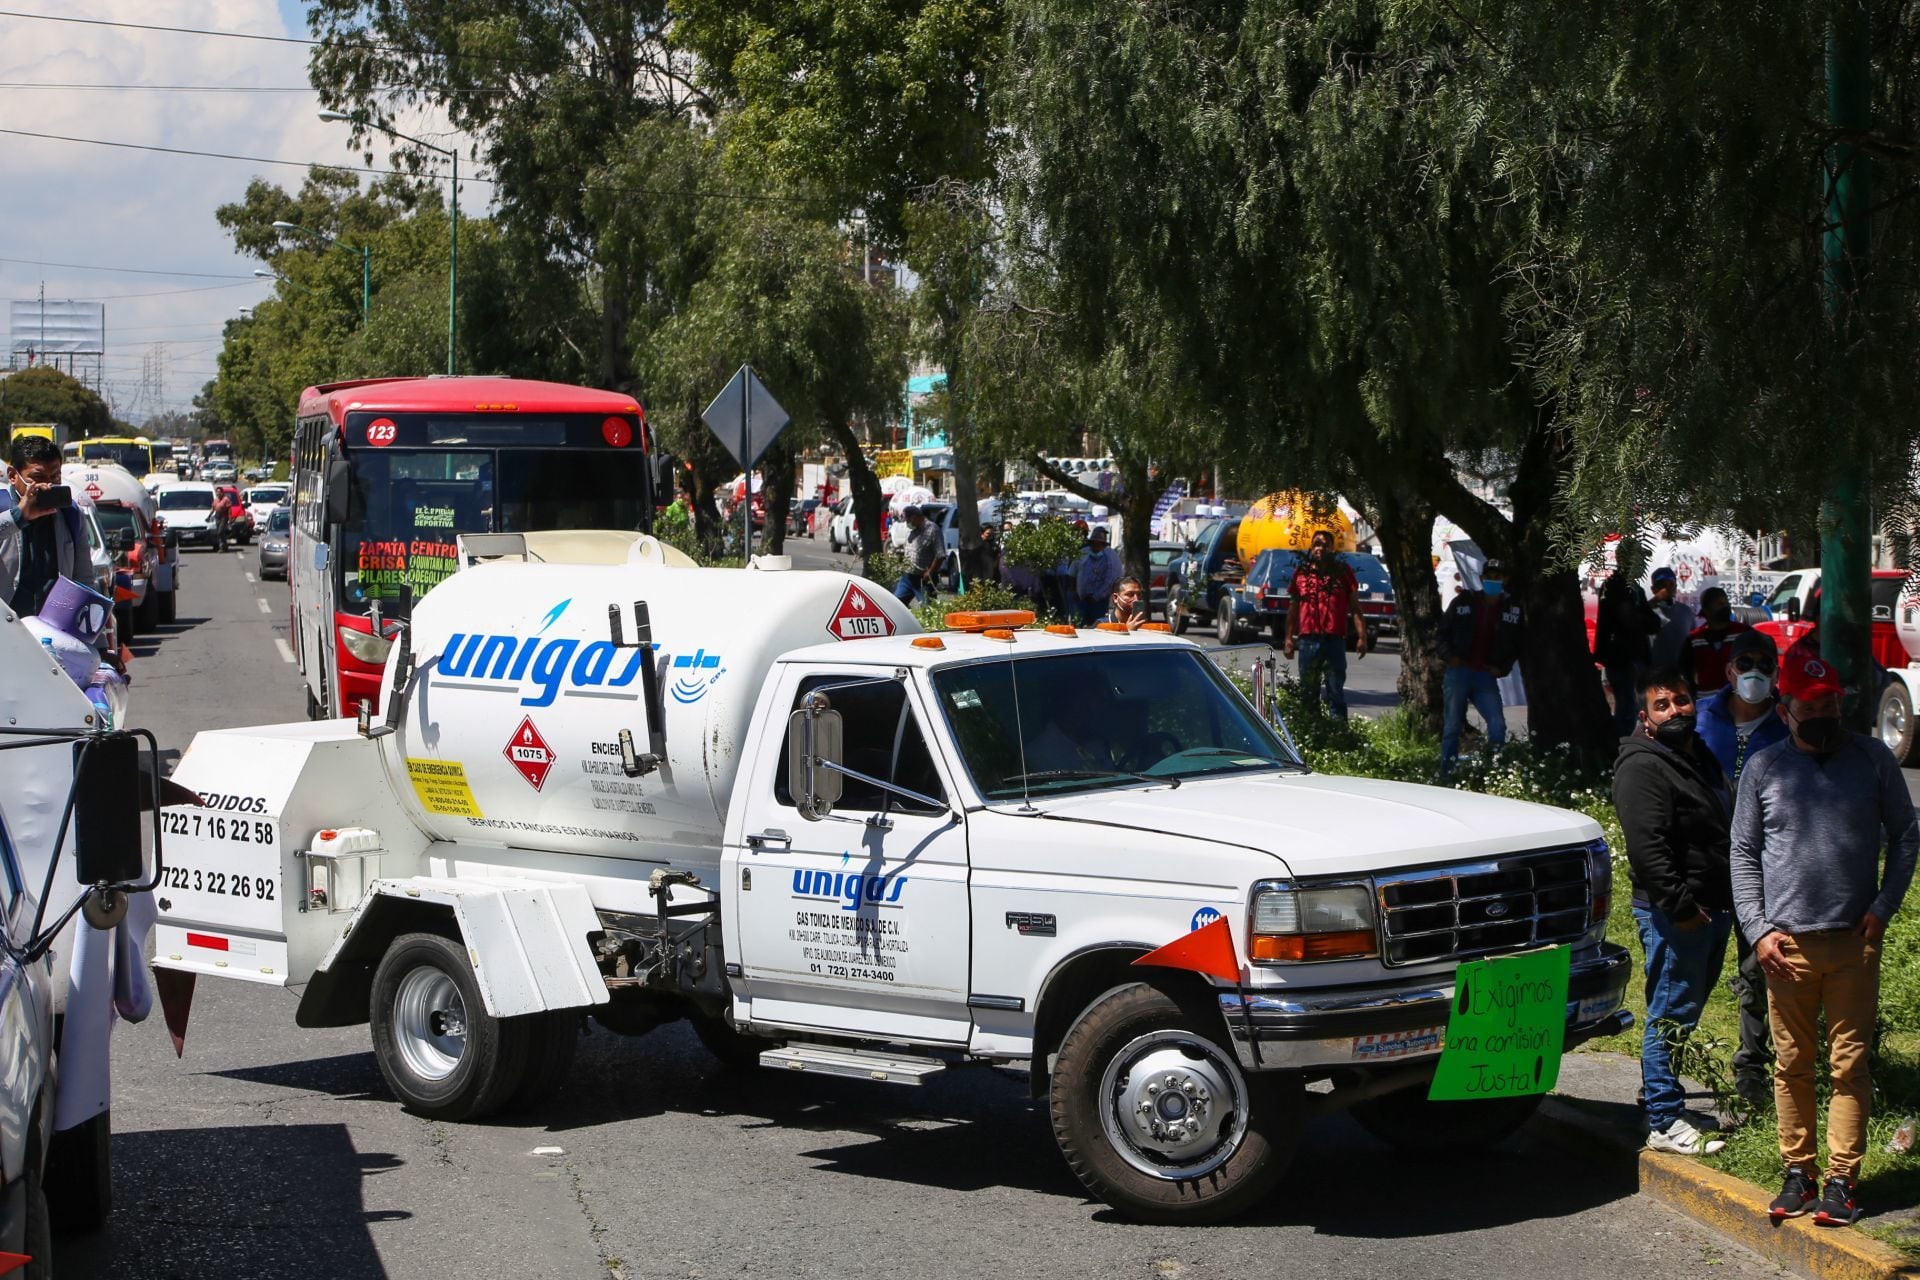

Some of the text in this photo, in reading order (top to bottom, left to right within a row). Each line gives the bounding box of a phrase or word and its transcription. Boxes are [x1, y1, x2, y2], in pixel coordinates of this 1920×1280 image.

[368, 425, 396, 440] 123
[85, 473, 99, 481] 383
[414, 520, 454, 528] DEPORTIVA
[359, 541, 457, 559] ZAPATA CENTRO
[358, 556, 406, 570] CRISA
[416, 555, 457, 572] QUINTANA ROO
[358, 570, 405, 584] PILARES
[848, 618, 880, 635] 1075
[437, 633, 661, 708] unigas
[709, 667, 727, 685] GPS
[517, 748, 543, 760] 1075
[591, 742, 622, 756] ENCIER
[530, 773, 538, 783] 2
[198, 791, 269, 814] EDIDOS.
[161, 812, 273, 845] 722 7 16 22 58
[467, 817, 639, 841] SERVICIO A TANQUES ESTACIONARIOS
[162, 866, 275, 901] 722 3 22 26 92
[792, 869, 909, 911] unigas
[796, 911, 900, 936] GAS TOMZA DE MEXICO S.A. DE C.V.
[810, 963, 894, 981] 01 722) 274-3400
